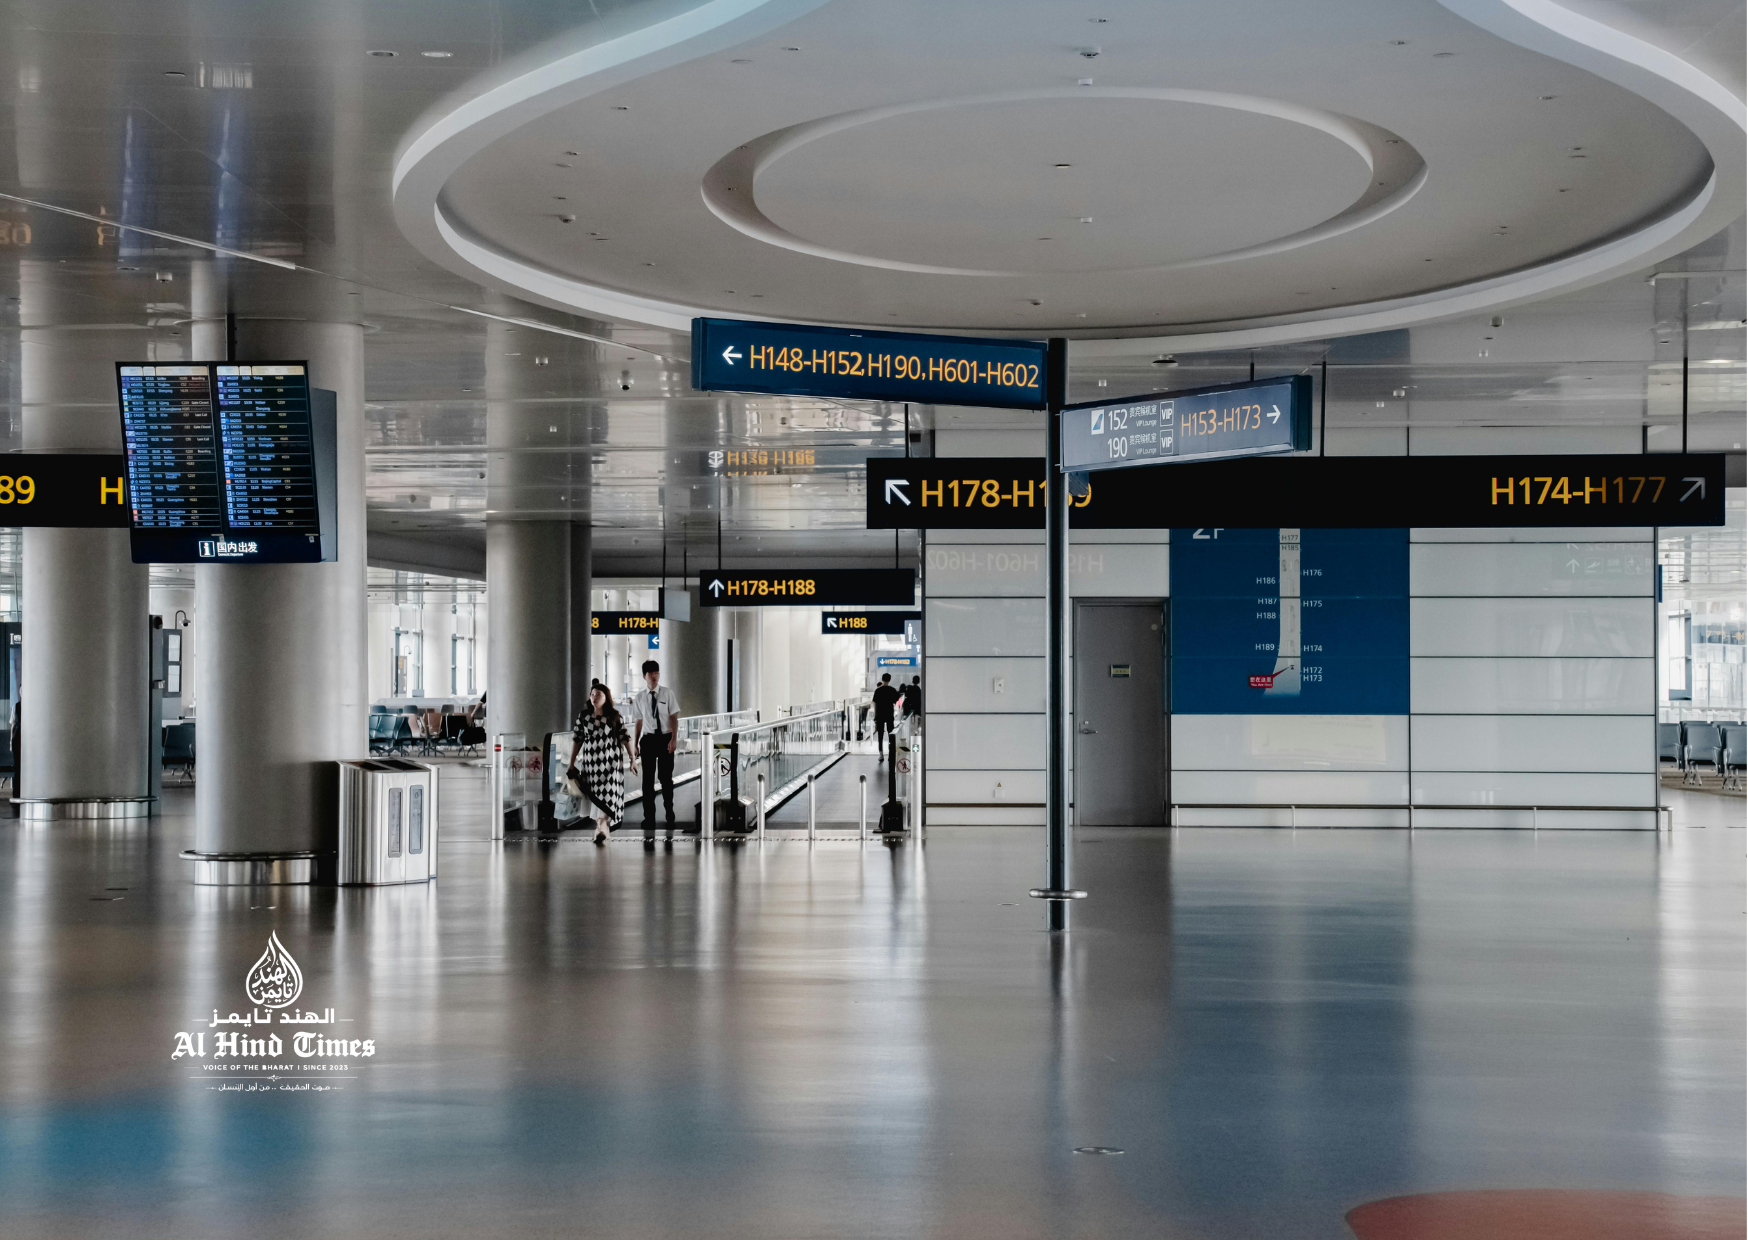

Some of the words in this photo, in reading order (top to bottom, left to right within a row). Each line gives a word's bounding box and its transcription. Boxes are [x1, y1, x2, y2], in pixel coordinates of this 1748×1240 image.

[1108, 408, 1128, 430] 152
[1161, 408, 1173, 420] VIP
[1181, 404, 1261, 438] H153-H173
[1108, 436, 1128, 458] 190
[1161, 437, 1173, 448] VIP
[1492, 476, 1666, 505] H174-H177
[217, 542, 258, 553] 国内出发
[727, 580, 815, 596] H178-H188
[839, 618, 867, 628] H188
